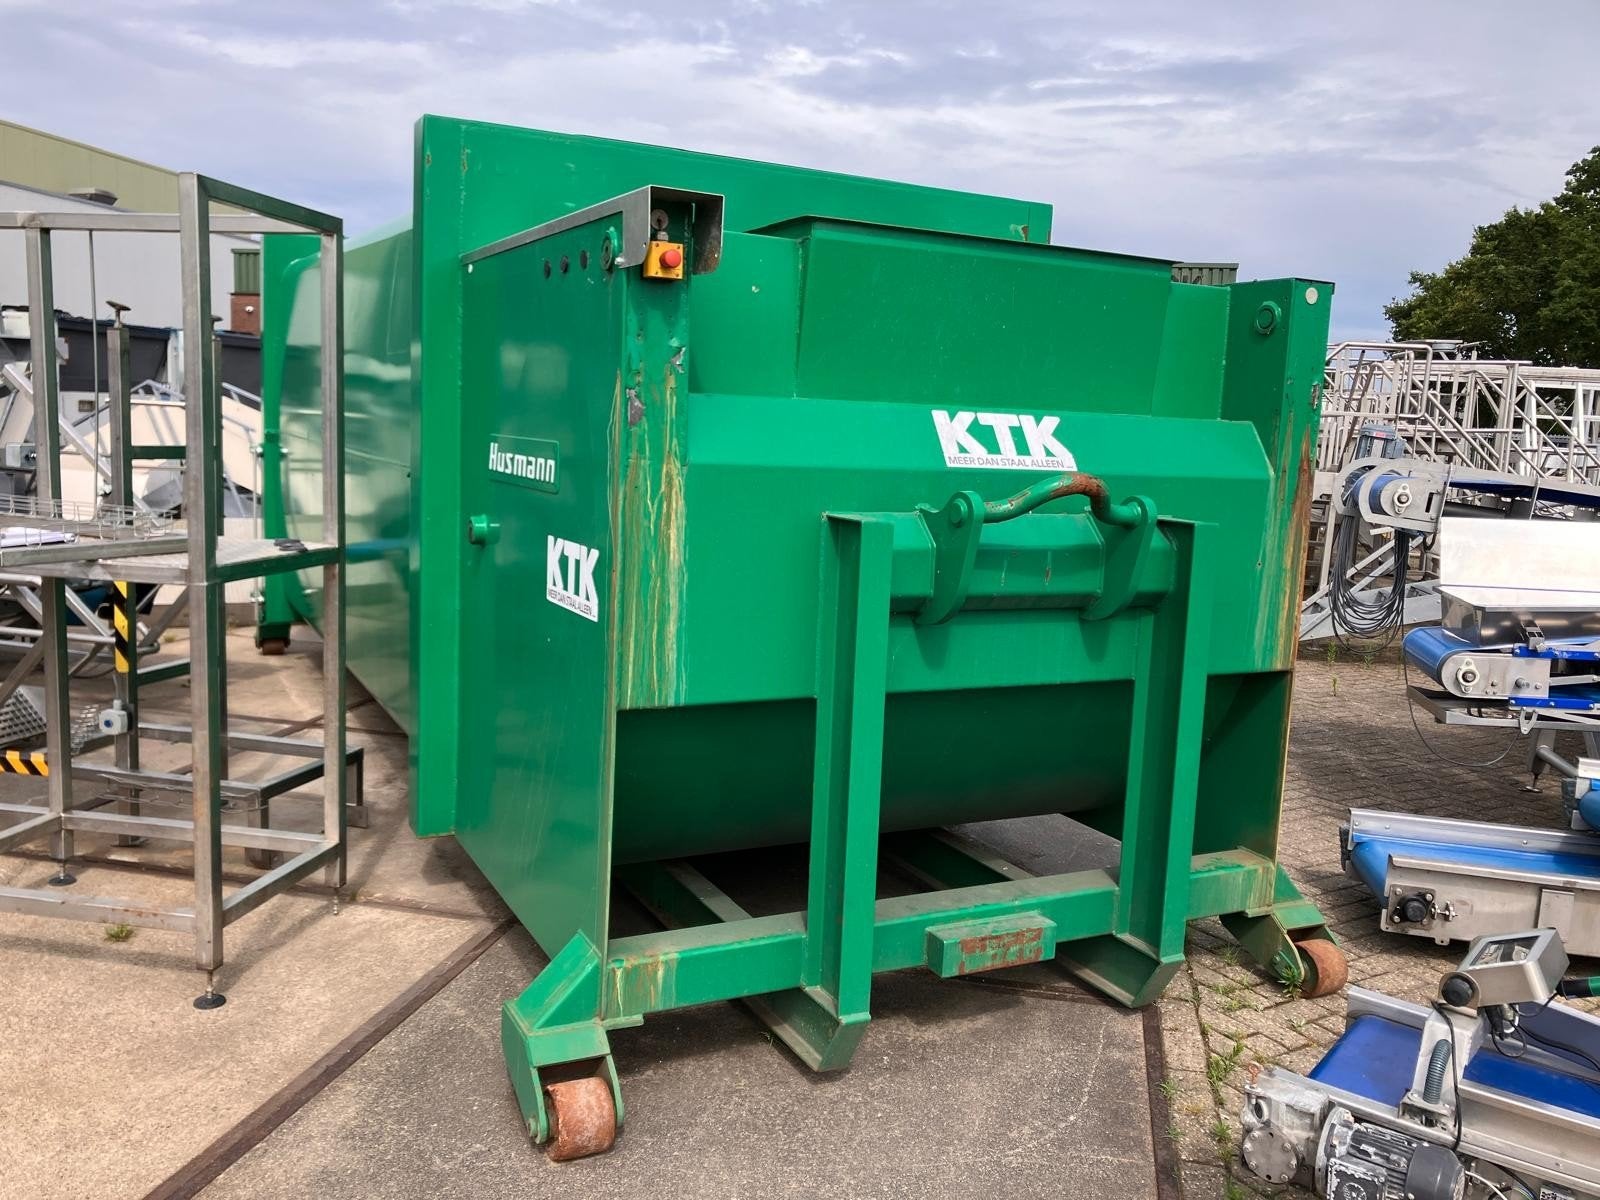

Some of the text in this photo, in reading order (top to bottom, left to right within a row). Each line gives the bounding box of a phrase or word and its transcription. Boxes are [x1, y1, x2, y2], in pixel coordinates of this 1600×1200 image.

[931, 409, 1074, 459] KTK
[488, 442, 556, 484] Husmann
[947, 456, 976, 466] MEER
[977, 457, 999, 467] DAN
[1000, 458, 1029, 468] STAAL
[547, 535, 600, 605] KTK
